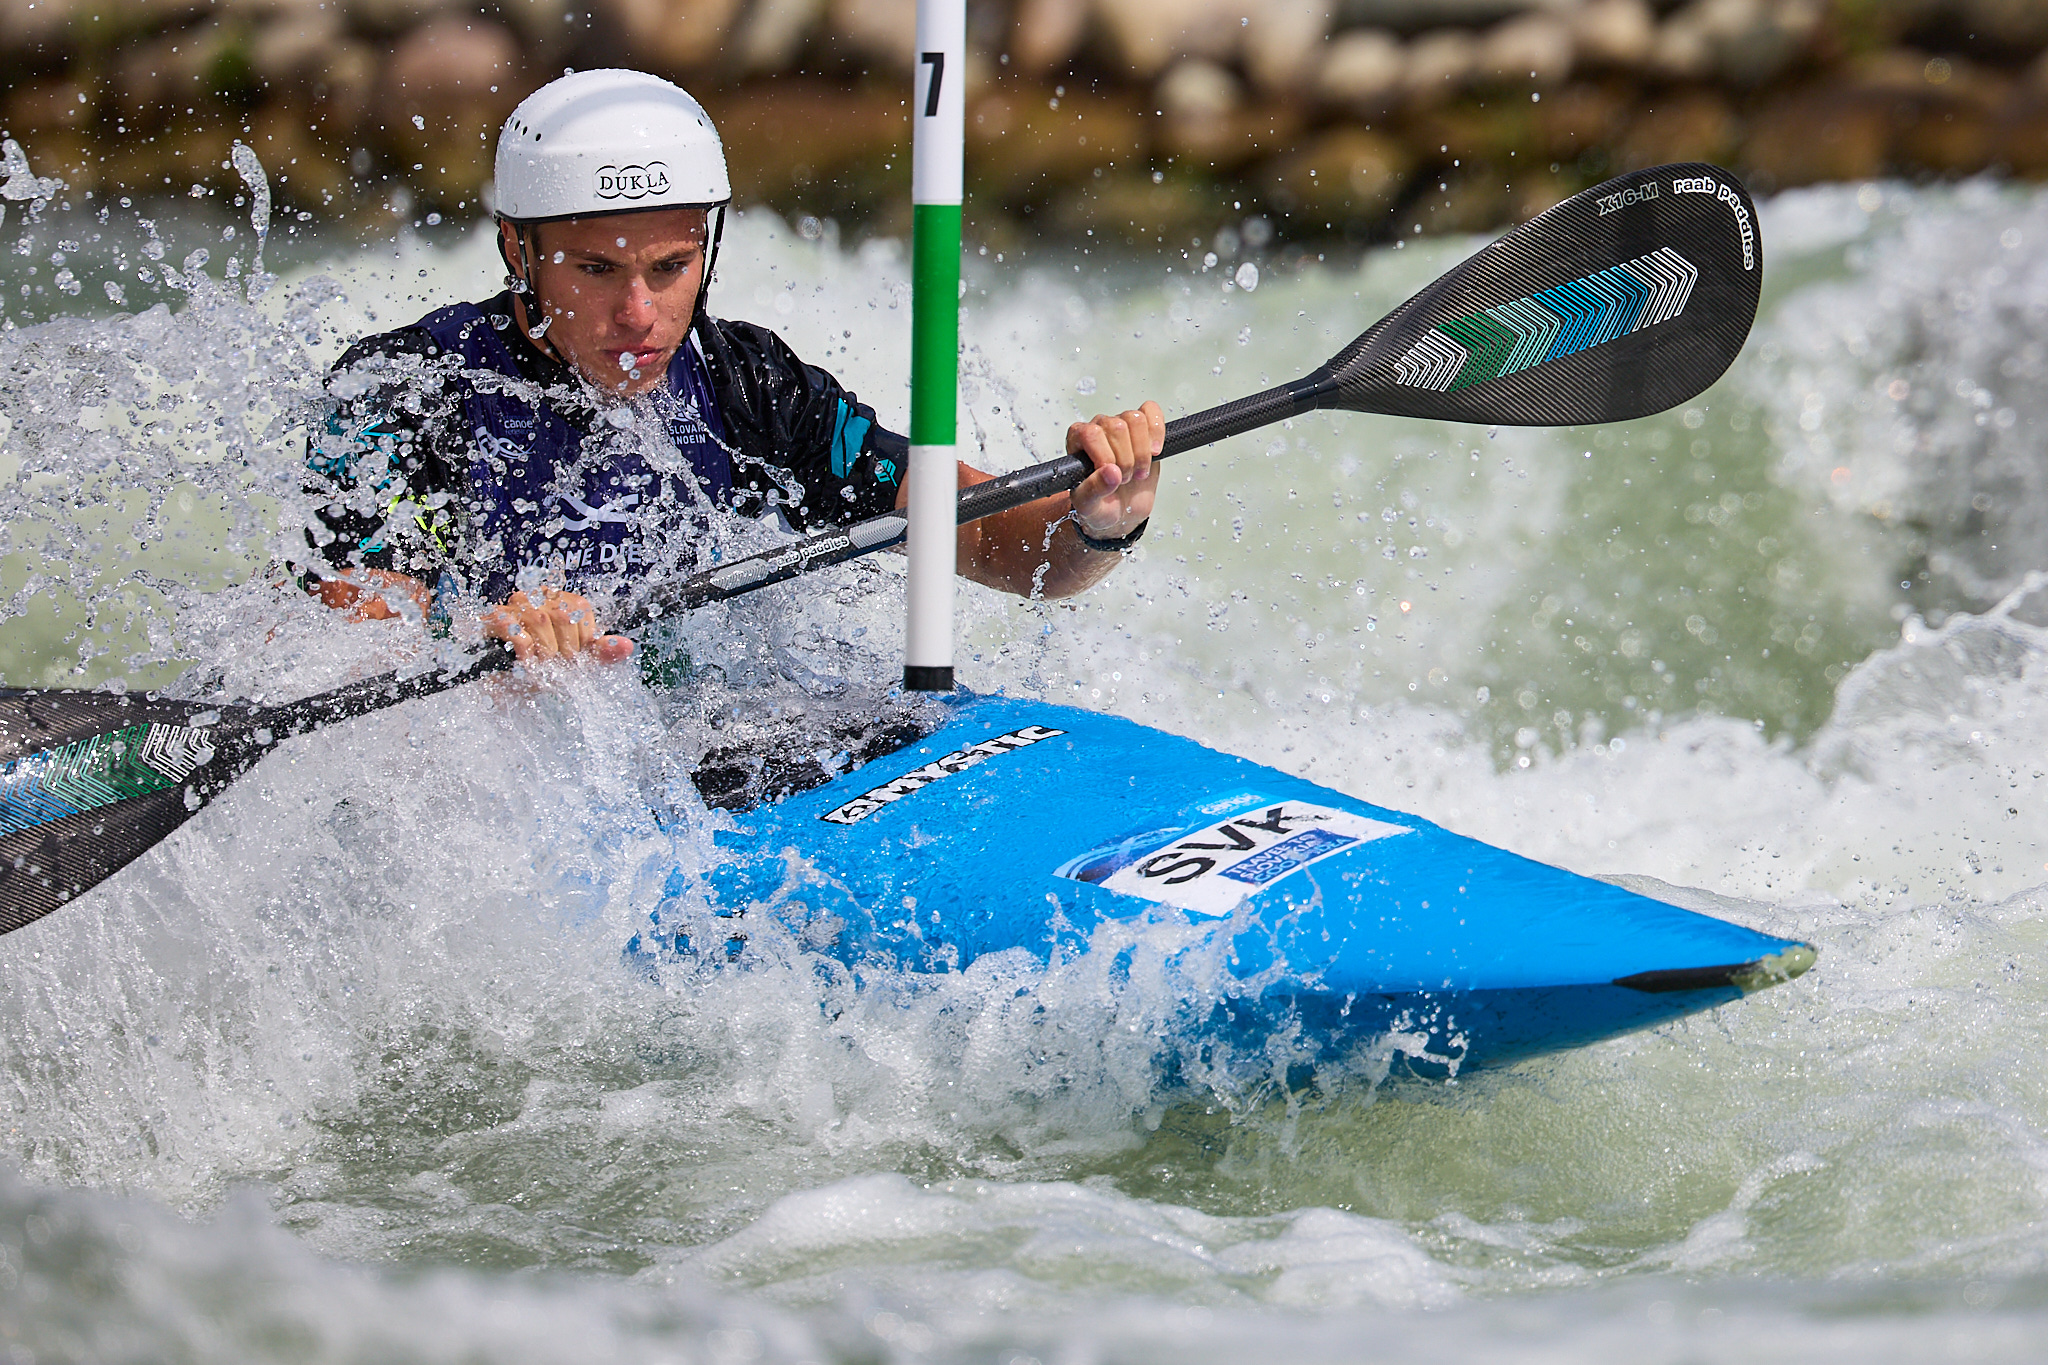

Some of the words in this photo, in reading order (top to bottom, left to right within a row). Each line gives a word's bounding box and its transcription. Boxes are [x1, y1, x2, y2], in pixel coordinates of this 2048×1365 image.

[921, 52, 945, 117] 7
[599, 171, 669, 191] DUKLA
[1596, 182, 1659, 216] X16-M
[1673, 177, 1716, 194] raab
[1717, 184, 1754, 271] paddles
[503, 419, 534, 429] canoe
[800, 535, 850, 562] paddles
[1136, 806, 1333, 885] SVK
[1226, 838, 1292, 875] TRAVEL
[1254, 850, 1308, 882] GOO
